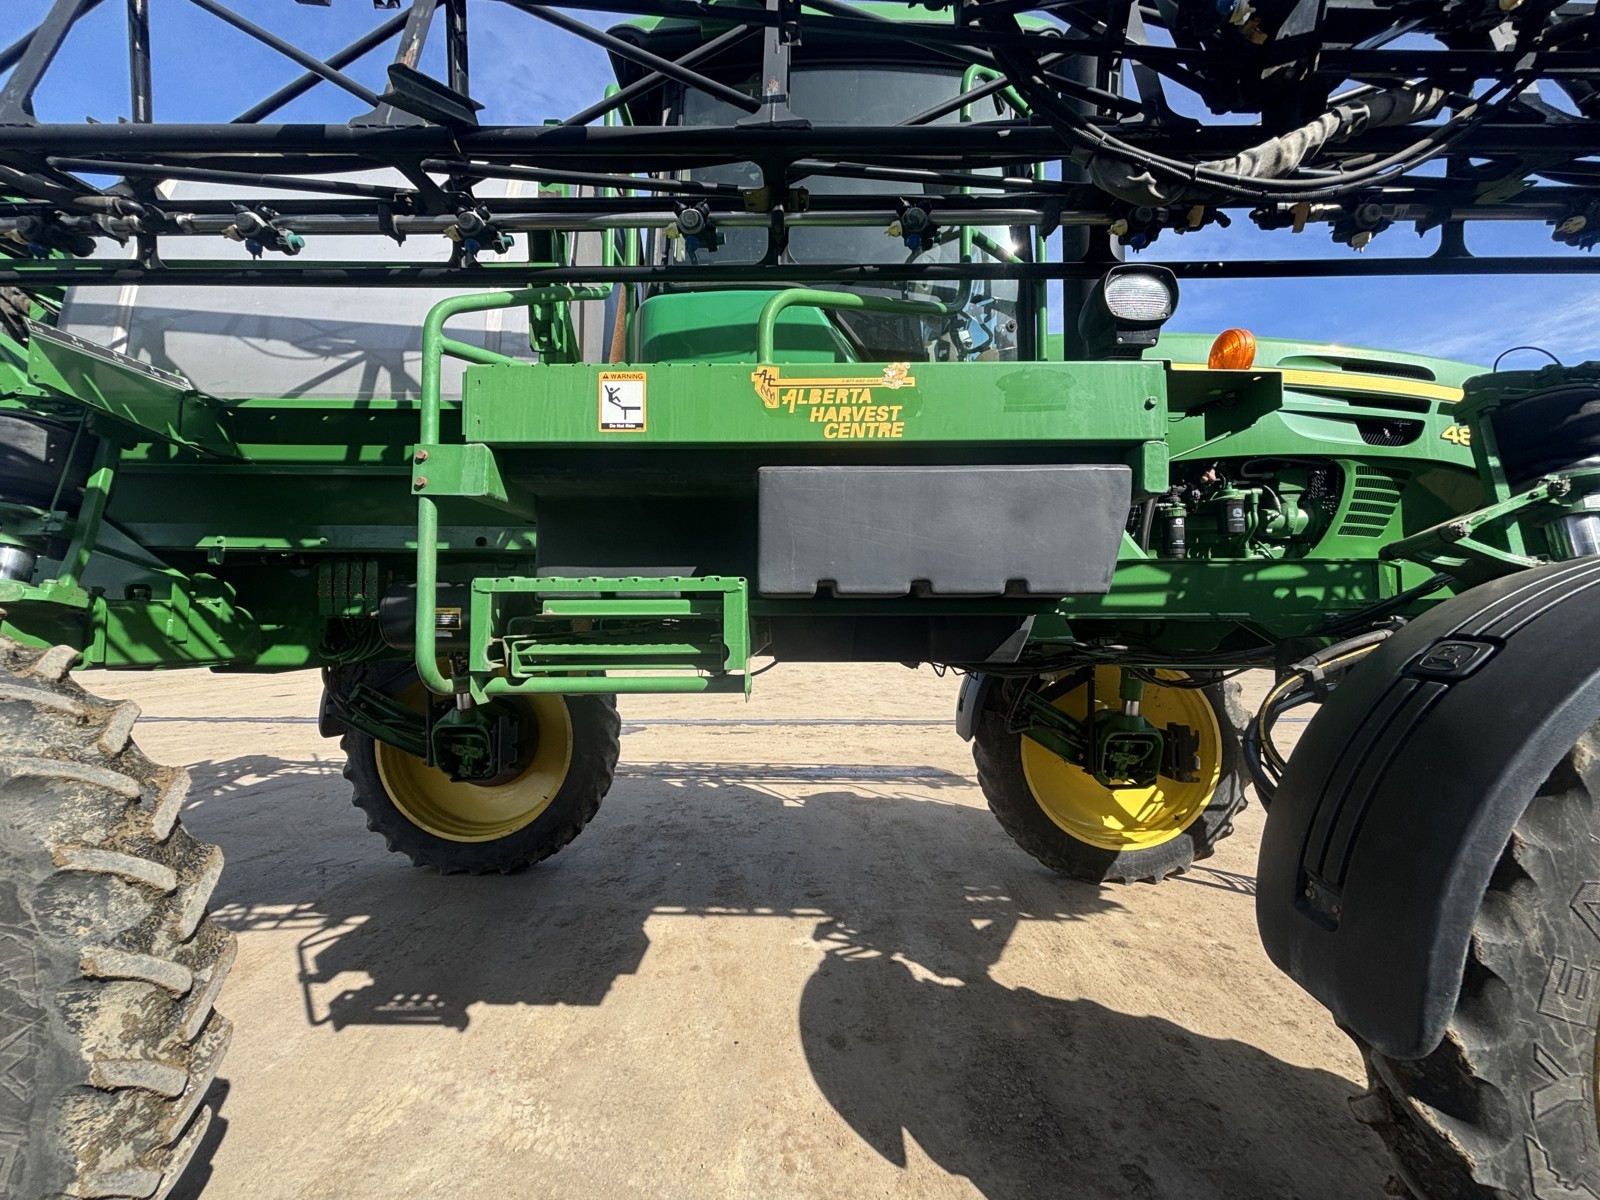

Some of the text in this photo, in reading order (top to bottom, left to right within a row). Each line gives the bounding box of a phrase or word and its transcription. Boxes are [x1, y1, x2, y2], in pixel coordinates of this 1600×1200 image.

[782, 388, 872, 414] ALBERTA
[810, 405, 903, 423] HARVEST
[823, 421, 905, 439] CENTRE
